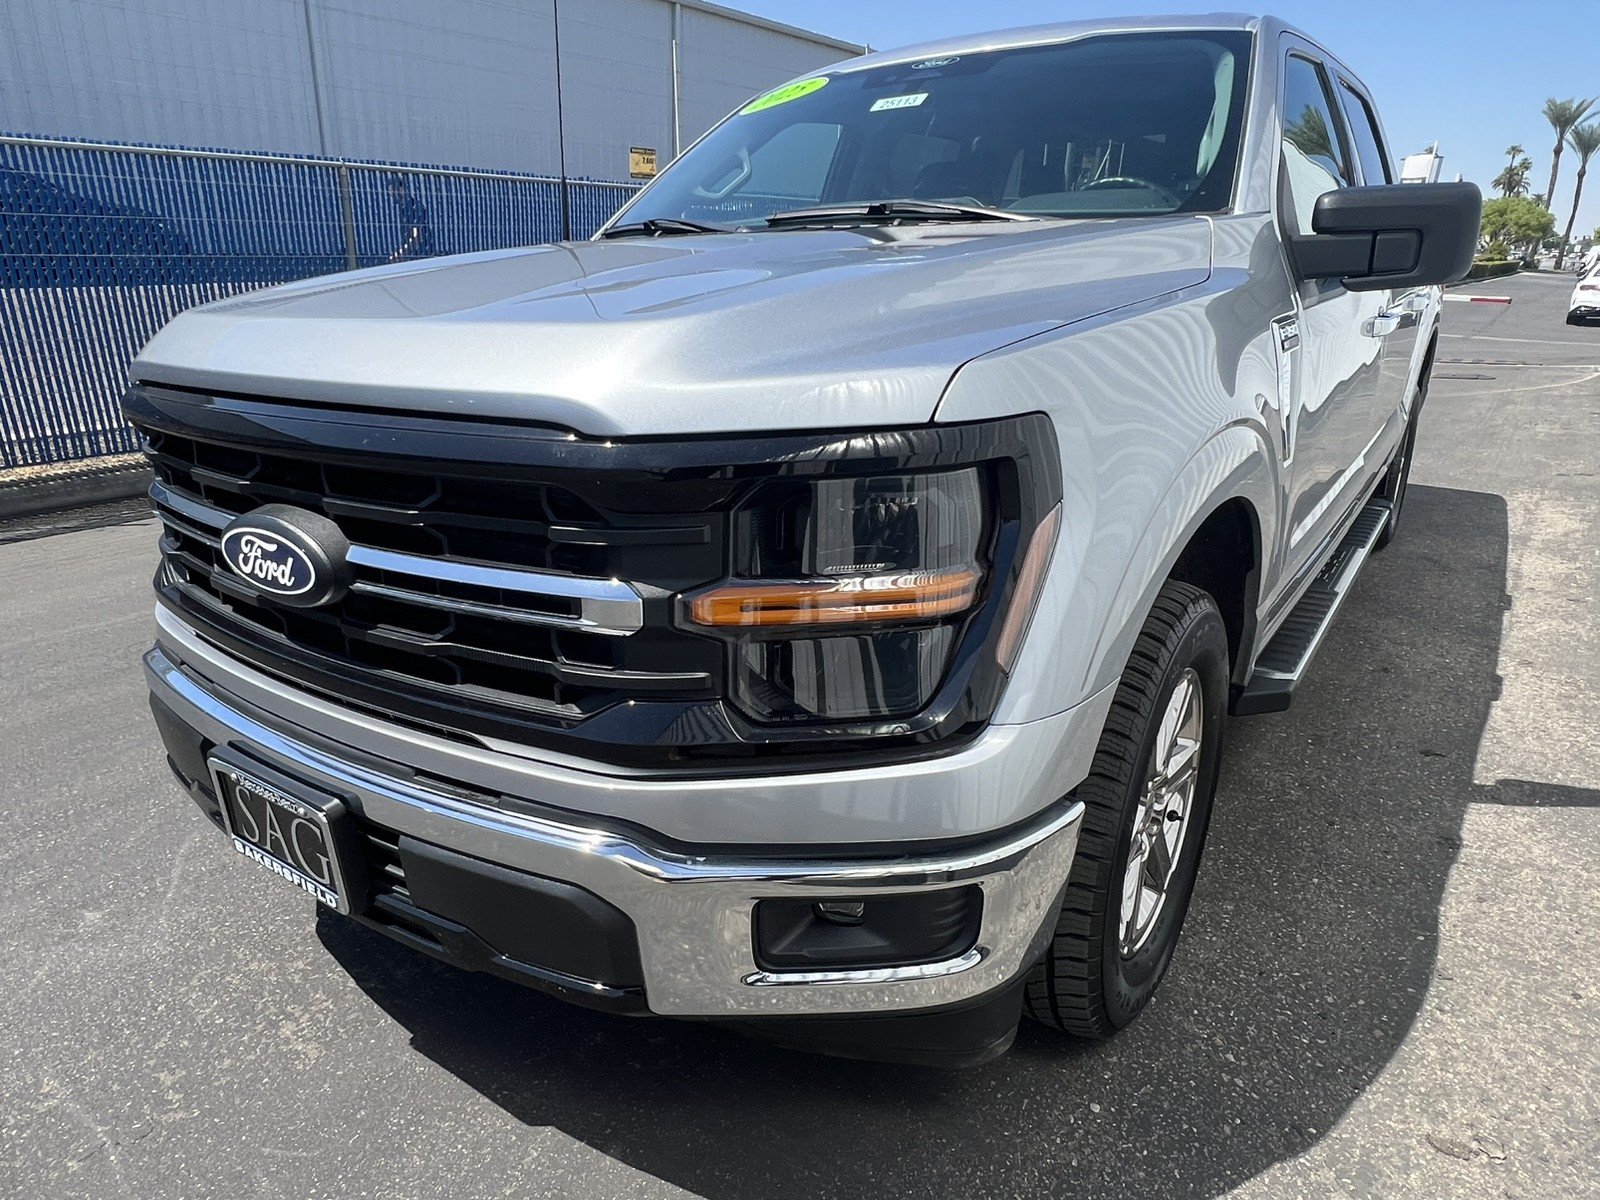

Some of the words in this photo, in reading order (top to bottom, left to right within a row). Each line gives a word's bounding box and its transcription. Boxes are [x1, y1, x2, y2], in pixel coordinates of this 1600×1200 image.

[880, 97, 918, 109] 25113
[238, 534, 296, 587] Ford
[235, 784, 331, 886] SAG
[232, 838, 338, 909] BAKERSFIELD
